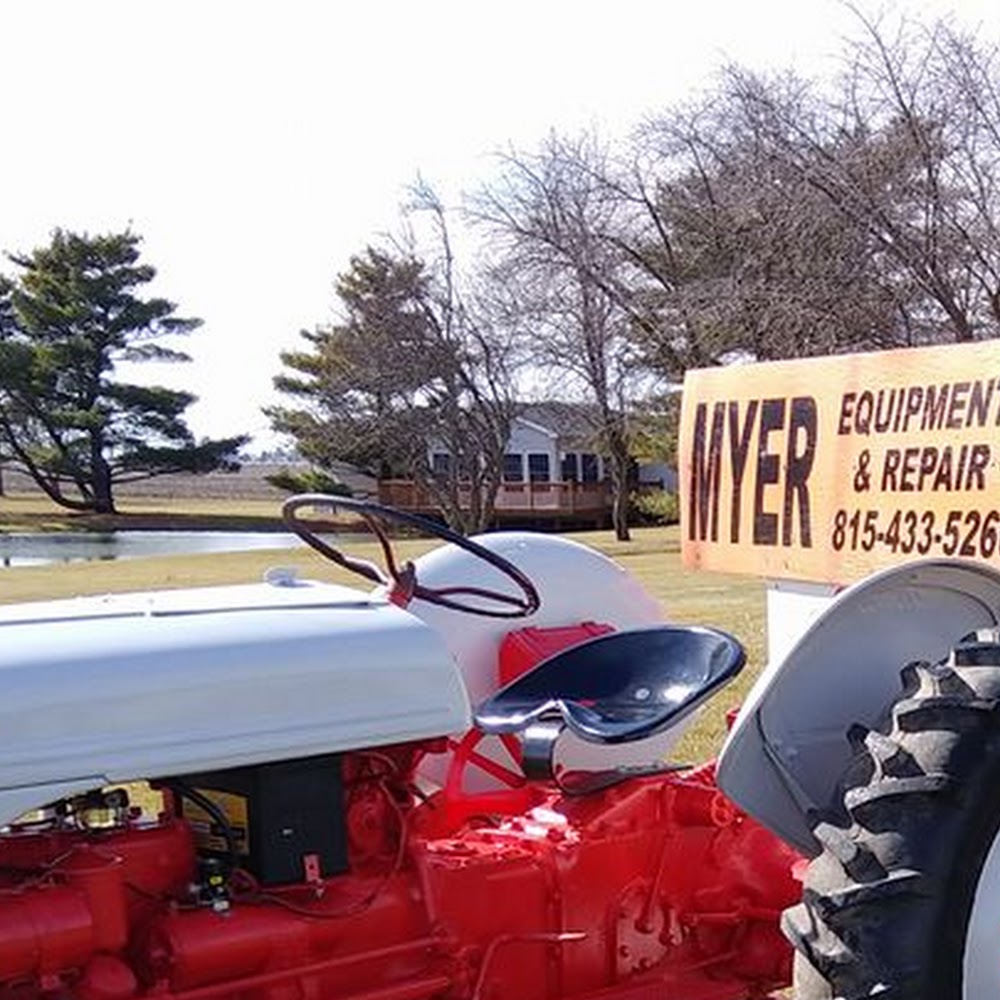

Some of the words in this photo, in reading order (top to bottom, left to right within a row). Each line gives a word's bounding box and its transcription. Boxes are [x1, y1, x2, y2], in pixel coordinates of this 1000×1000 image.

[688, 396, 818, 548] MYER
[853, 449, 871, 493] &
[881, 443, 991, 493] REPAIR
